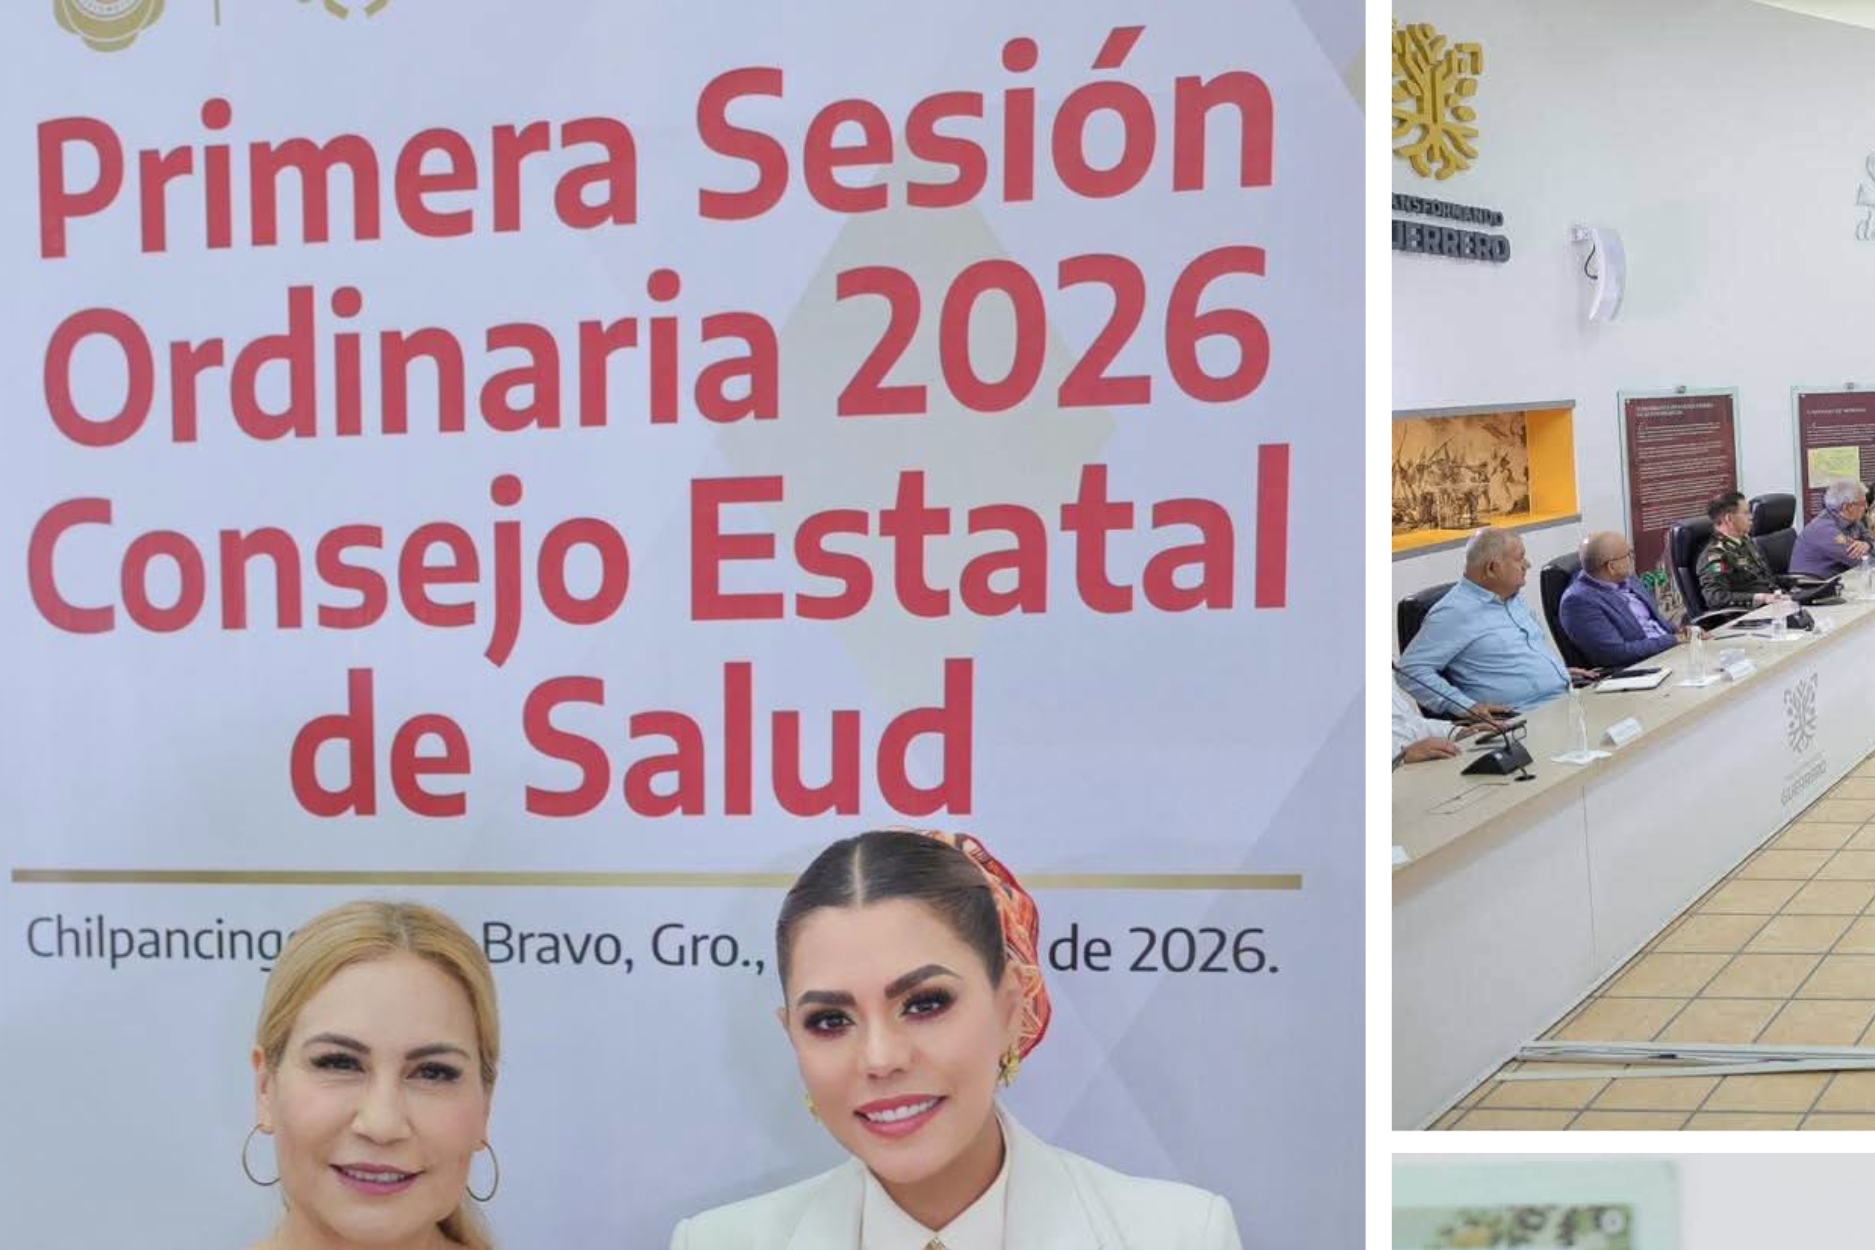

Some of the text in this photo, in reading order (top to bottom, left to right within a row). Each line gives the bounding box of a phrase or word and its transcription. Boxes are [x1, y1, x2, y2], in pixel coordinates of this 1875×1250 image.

[36, 26, 1276, 259] Primera Sesión
[43, 246, 1270, 446] Ordinaria 2026
[27, 443, 1290, 667] Consejo Estatal
[290, 657, 974, 818] de Salud
[27, 914, 1280, 974] Chilpancing Bravo, Gro., de 2026.
